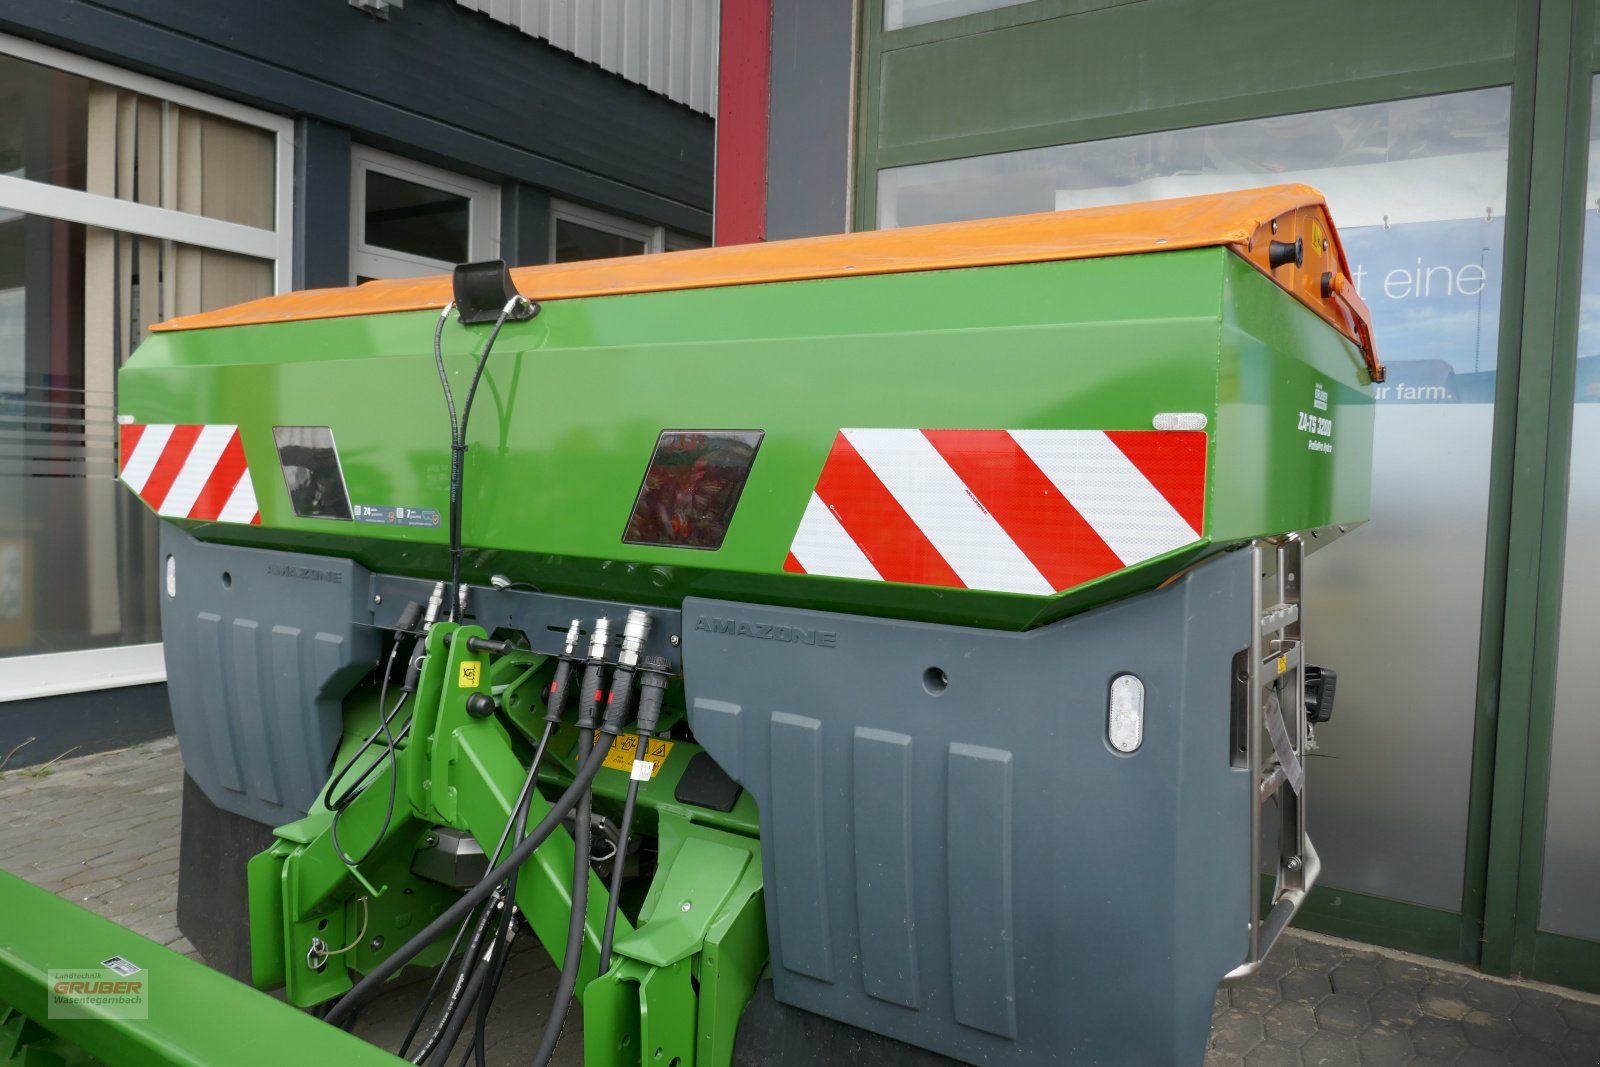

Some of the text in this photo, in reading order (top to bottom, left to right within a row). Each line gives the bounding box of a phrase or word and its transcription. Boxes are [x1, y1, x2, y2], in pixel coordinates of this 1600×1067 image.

[1384, 257, 1487, 299] eine
[1396, 383, 1452, 400] farm.
[1298, 411, 1332, 437] ZA-TS 3200
[363, 506, 371, 516] 24
[406, 509, 412, 518] 7
[694, 615, 837, 648] AMAZONE
